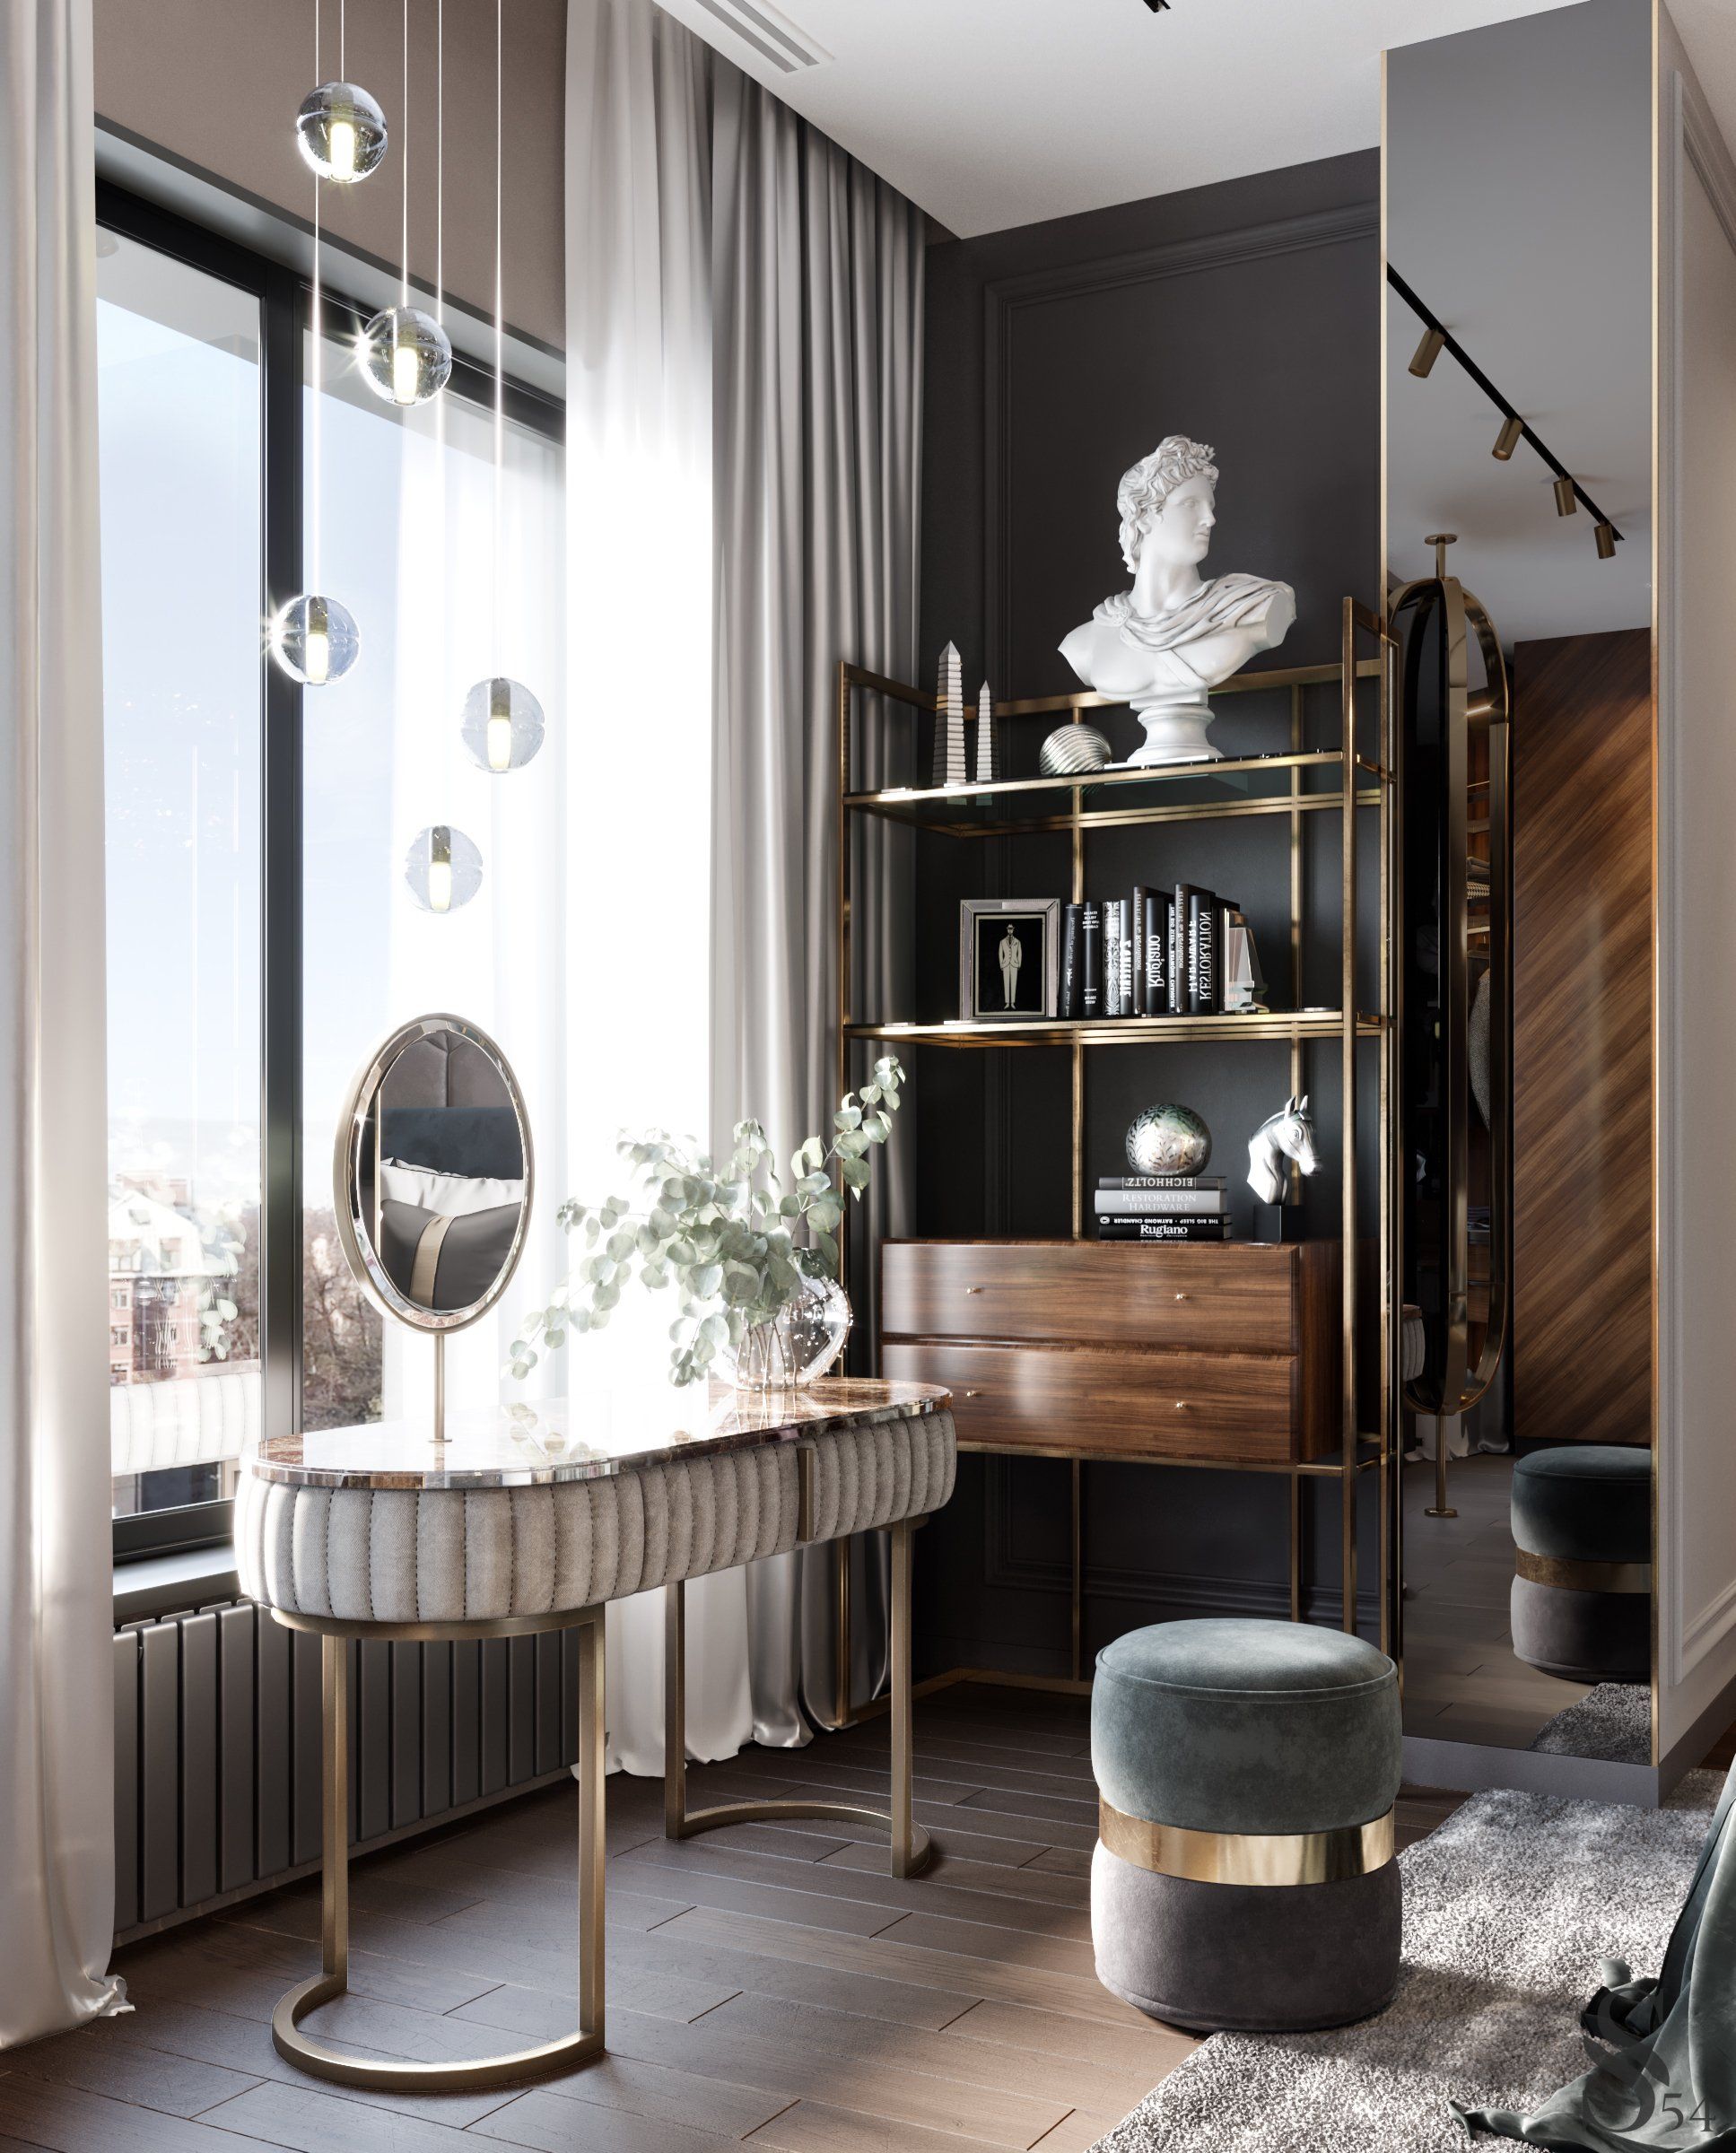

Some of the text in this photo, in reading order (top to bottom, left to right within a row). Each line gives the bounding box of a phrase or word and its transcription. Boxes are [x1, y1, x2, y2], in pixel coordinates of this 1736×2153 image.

[1128, 1177, 1193, 1187] EICHHOLTZ
[1121, 1193, 1197, 1202] RESTORATION
[1130, 1203, 1191, 1211] HARDWARE
[1140, 1225, 1189, 1238] Rugiano
